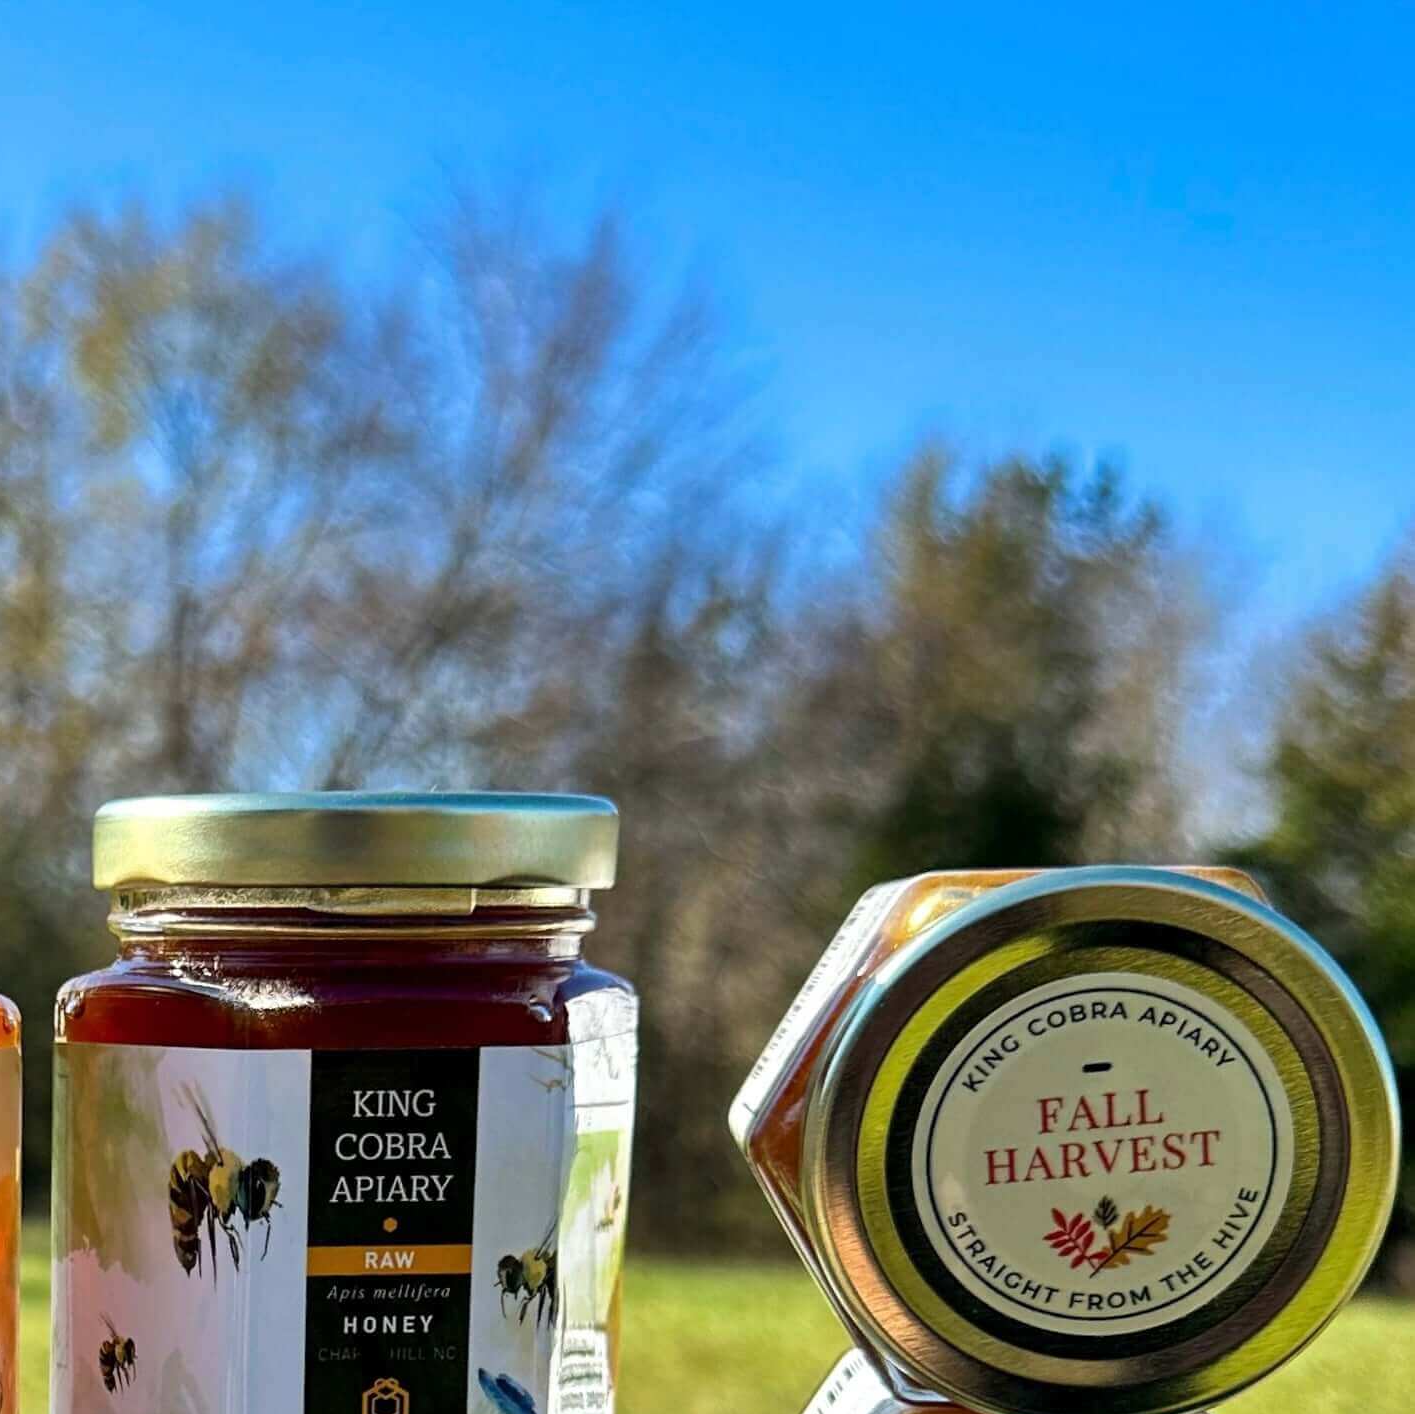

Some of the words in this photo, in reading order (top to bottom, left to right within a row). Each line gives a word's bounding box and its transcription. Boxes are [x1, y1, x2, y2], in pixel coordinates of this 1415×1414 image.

[962, 1039, 1021, 1094] KING
[1027, 1001, 1128, 1037] COBRA
[1138, 1007, 1238, 1068] APIARY
[352, 1089, 436, 1118] KING
[1037, 1089, 1164, 1135] FALL
[335, 1132, 452, 1161] COBRA
[985, 1130, 1221, 1186] HARVEST
[329, 1175, 454, 1203] APIARY
[365, 1251, 414, 1269] RAW
[948, 1211, 1059, 1304] STRAIGHT
[1068, 1285, 1151, 1310] FROM
[1160, 1251, 1213, 1294] THE
[1213, 1187, 1259, 1249] HIVE
[327, 1285, 365, 1302] Apis
[373, 1284, 451, 1302] mellifera
[344, 1315, 433, 1334] HONEY
[434, 1346, 457, 1360] NC
